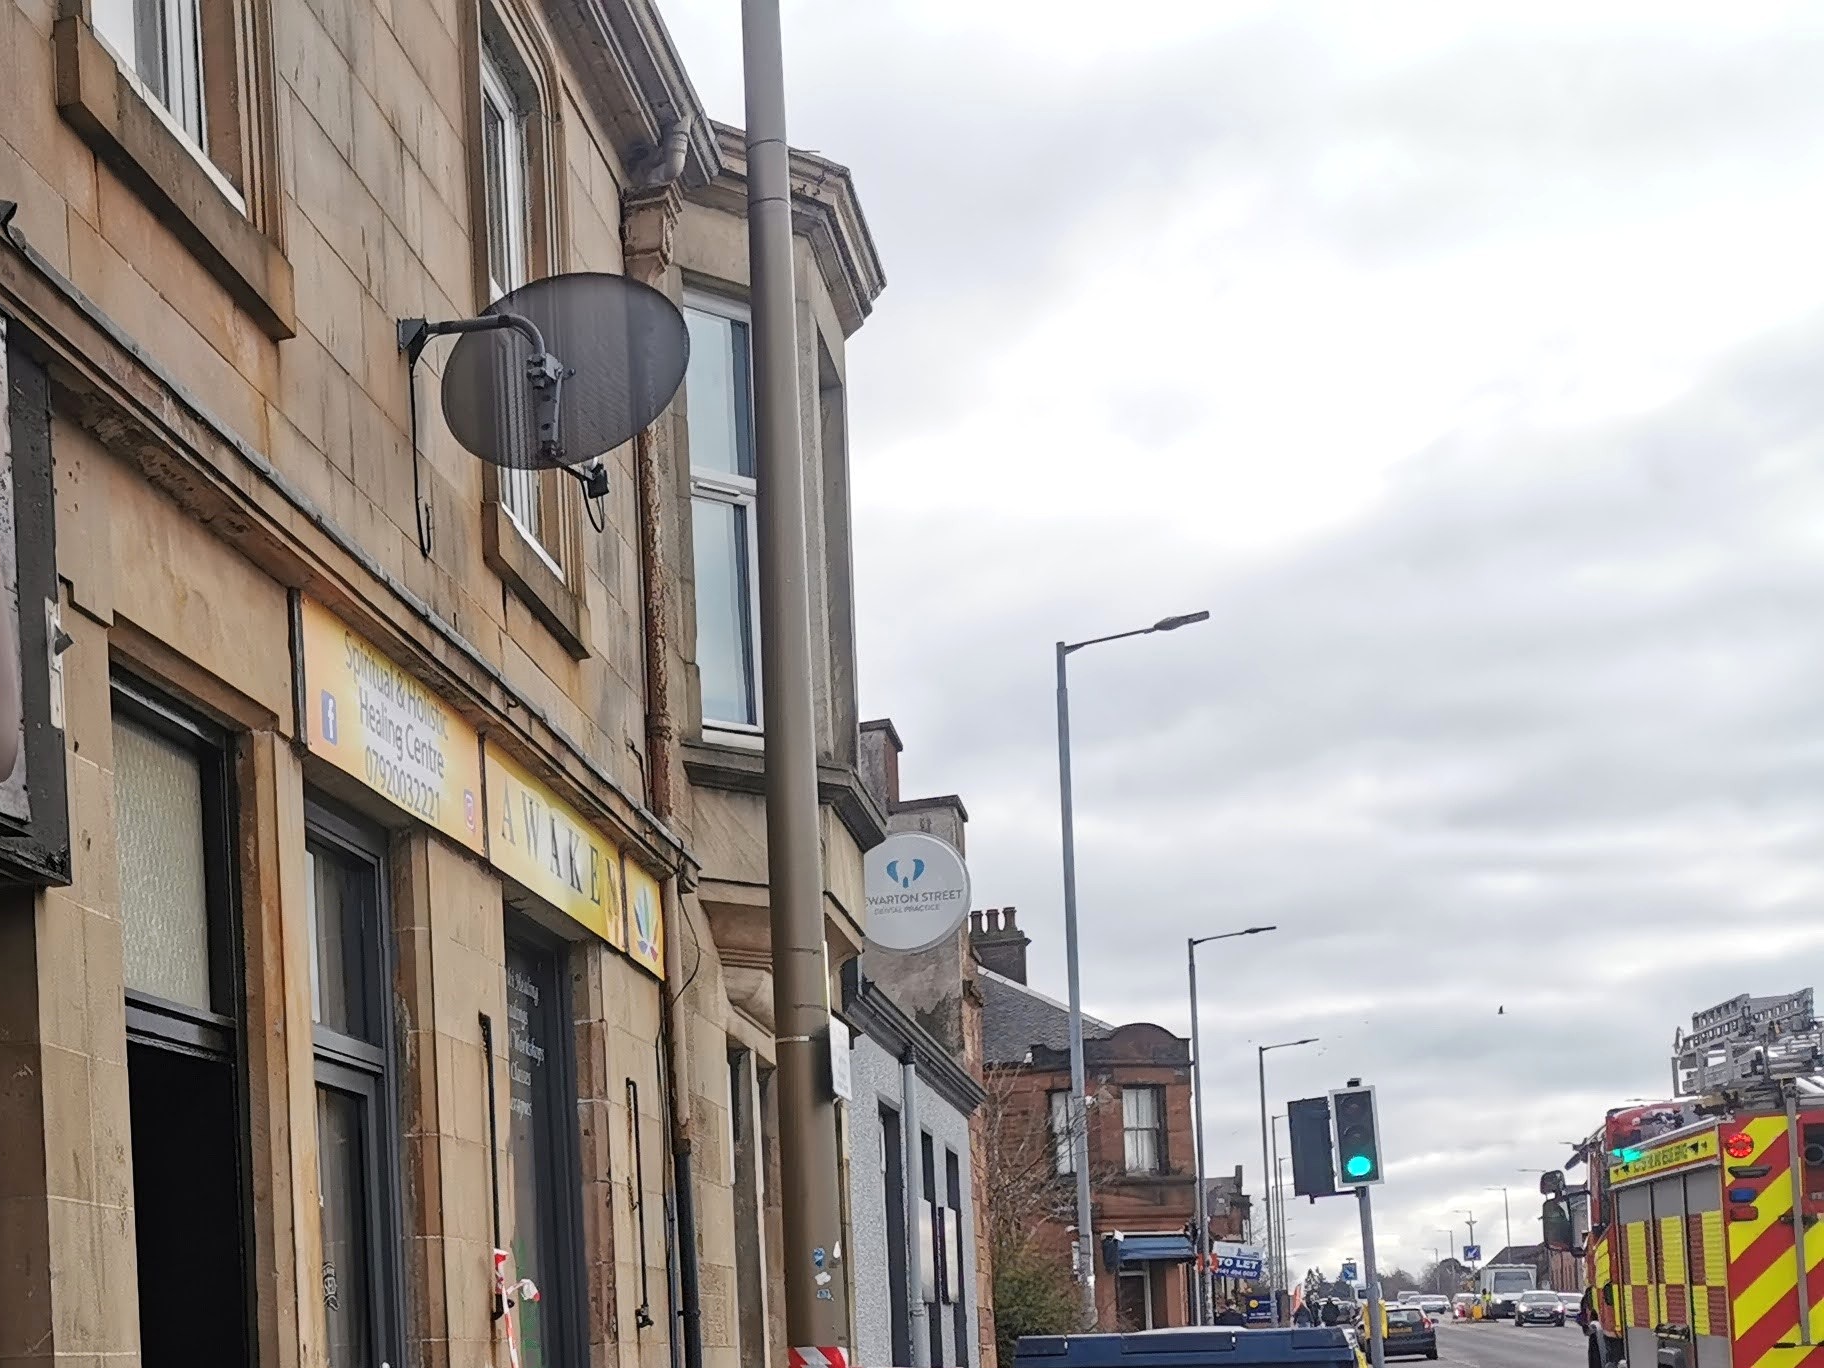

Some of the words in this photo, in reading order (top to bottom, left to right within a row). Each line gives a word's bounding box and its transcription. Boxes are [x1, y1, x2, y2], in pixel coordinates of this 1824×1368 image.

[344, 630, 395, 702] Spiritual
[407, 678, 450, 741] Holistic
[358, 686, 405, 762] Healing
[405, 723, 446, 780] Centre
[501, 776, 620, 926] AWAKEN
[921, 889, 963, 903] STREET
[1217, 1256, 1234, 1267] TO
[1236, 1259, 1258, 1269] LET
